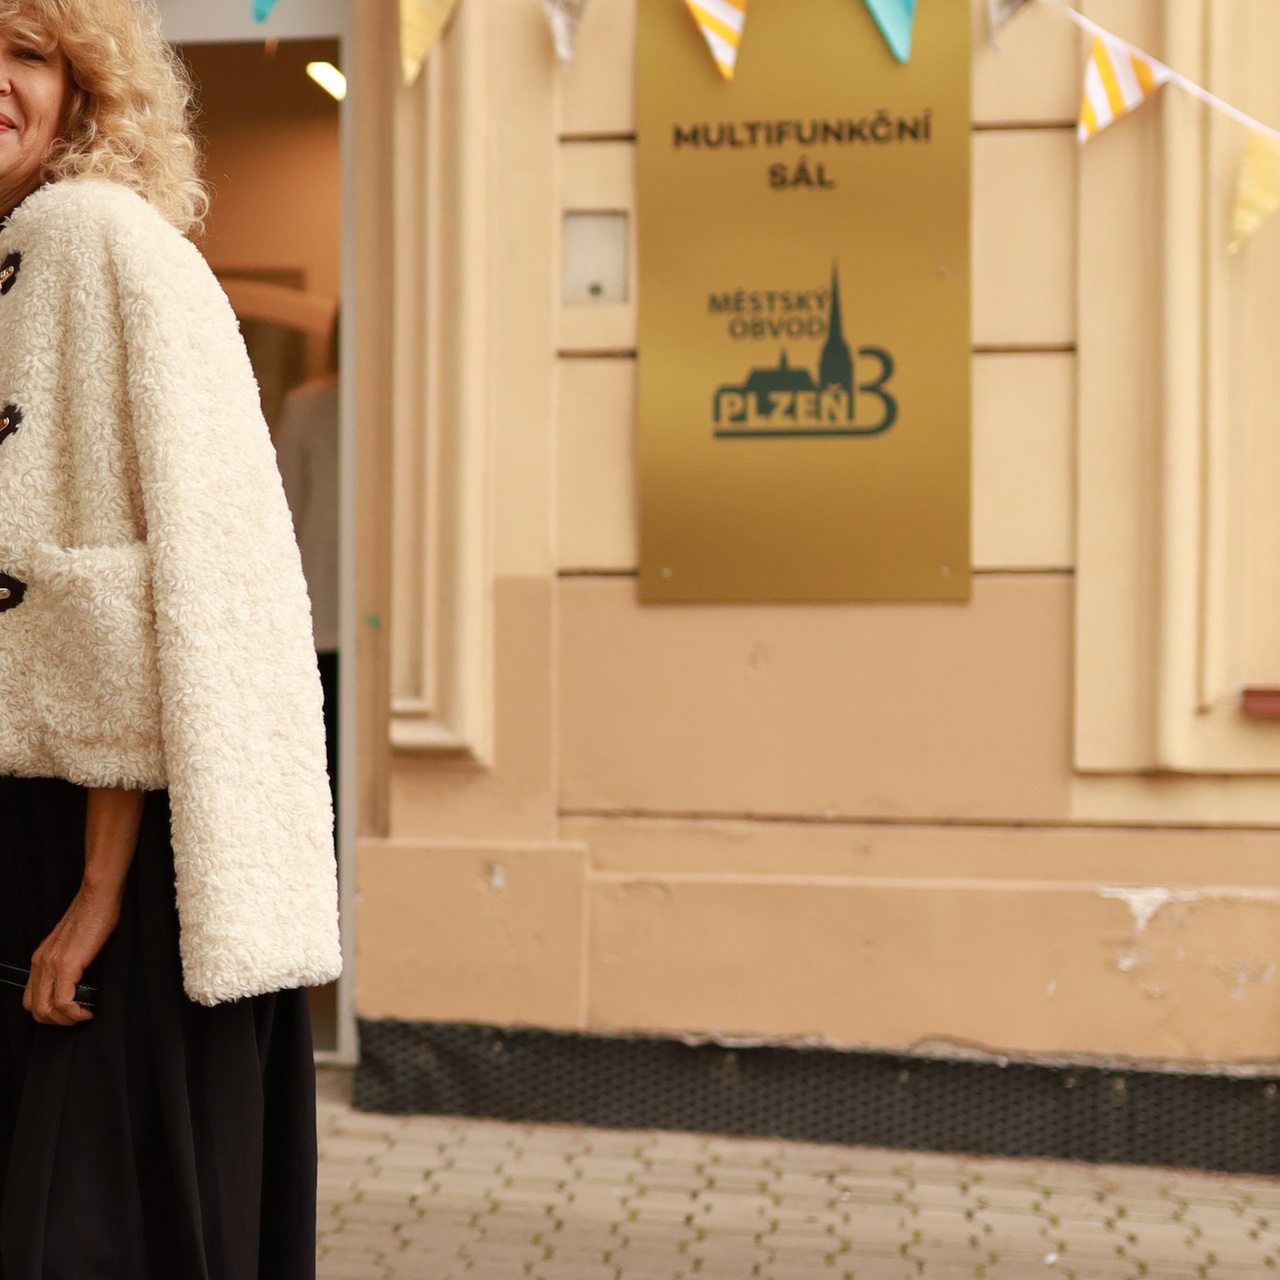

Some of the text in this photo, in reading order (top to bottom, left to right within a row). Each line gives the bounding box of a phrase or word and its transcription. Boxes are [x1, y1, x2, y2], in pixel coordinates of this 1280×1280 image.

[673, 109, 932, 148] MULTIFUNKČNÍ
[768, 156, 835, 190] SÁL
[708, 287, 828, 315] MĚSTSKÝ
[729, 316, 825, 340] OBVOD
[720, 346, 898, 436] PLZEŇ 3
